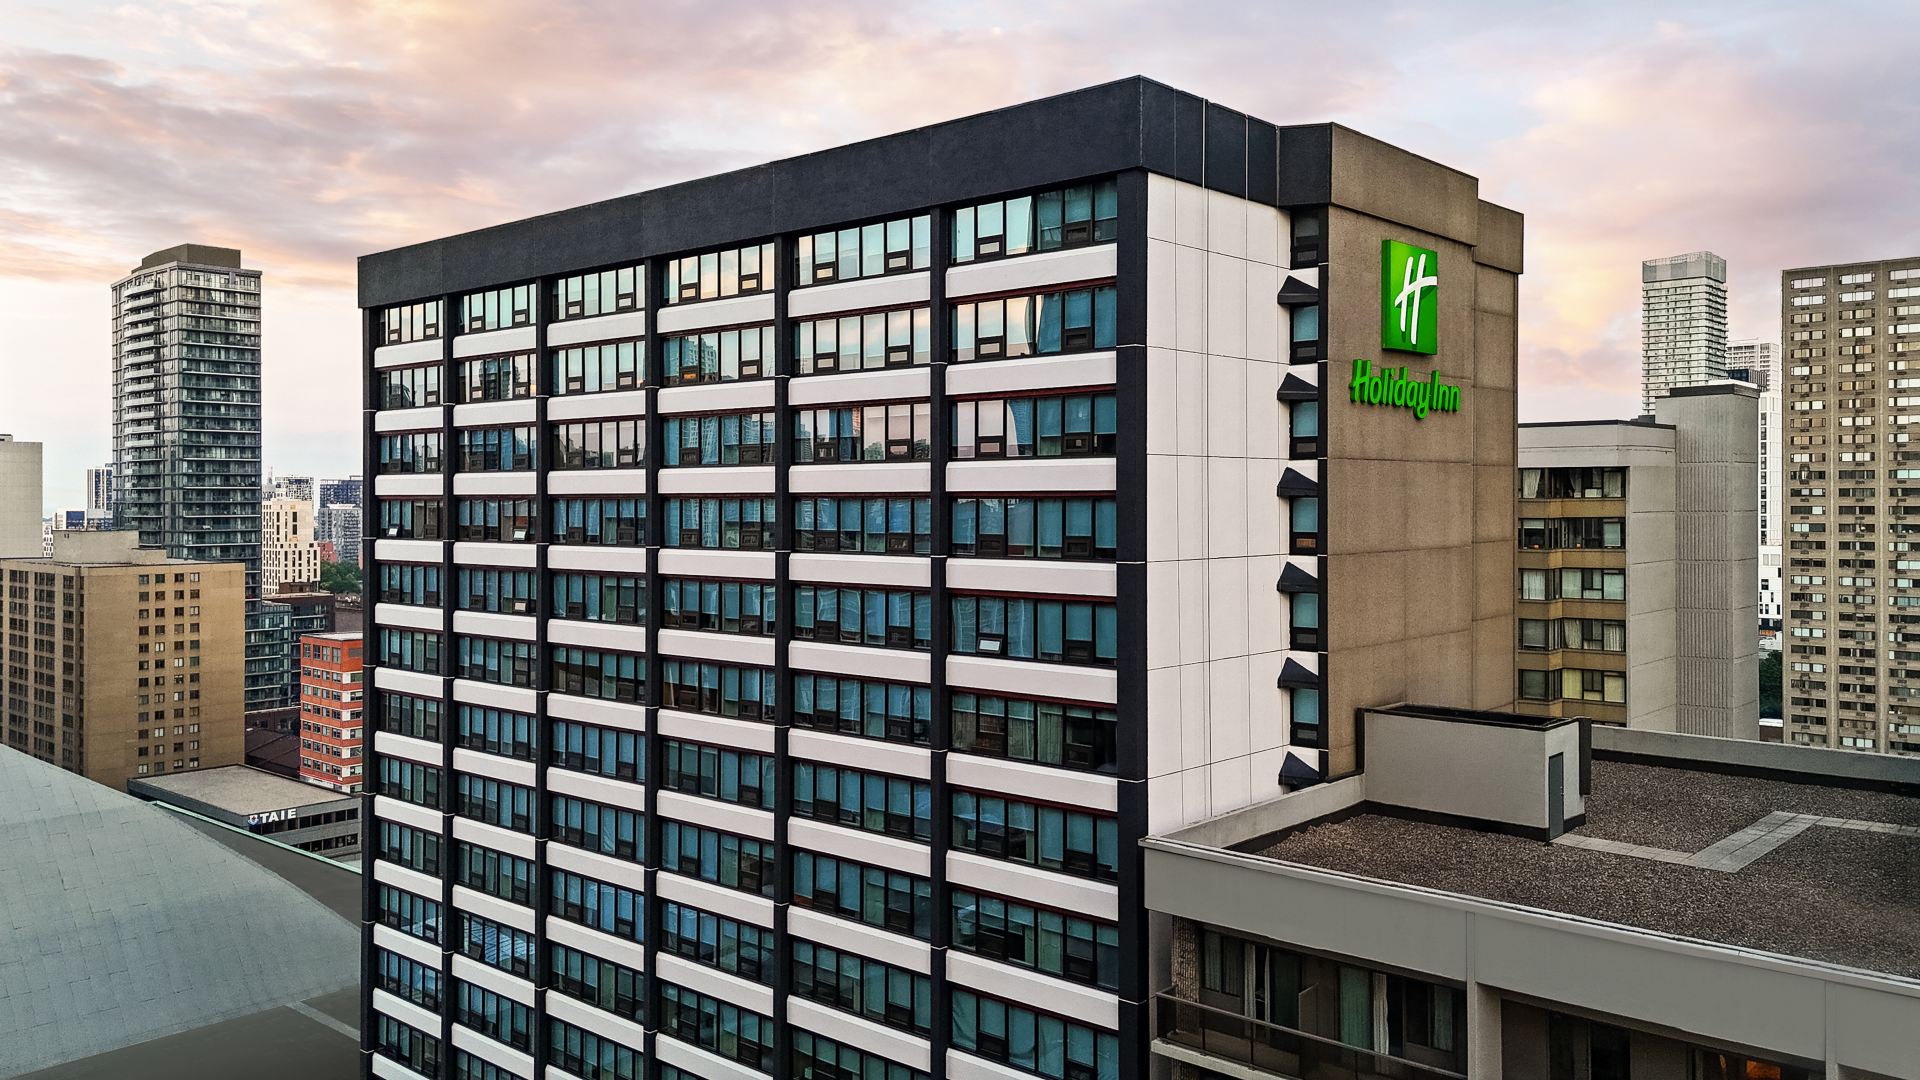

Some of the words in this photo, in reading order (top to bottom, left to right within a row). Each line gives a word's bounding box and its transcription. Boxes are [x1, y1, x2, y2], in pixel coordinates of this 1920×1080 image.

[1349, 359, 1430, 420] Holiday
[1430, 369, 1461, 413] Inn
[259, 808, 297, 824] TAIE
